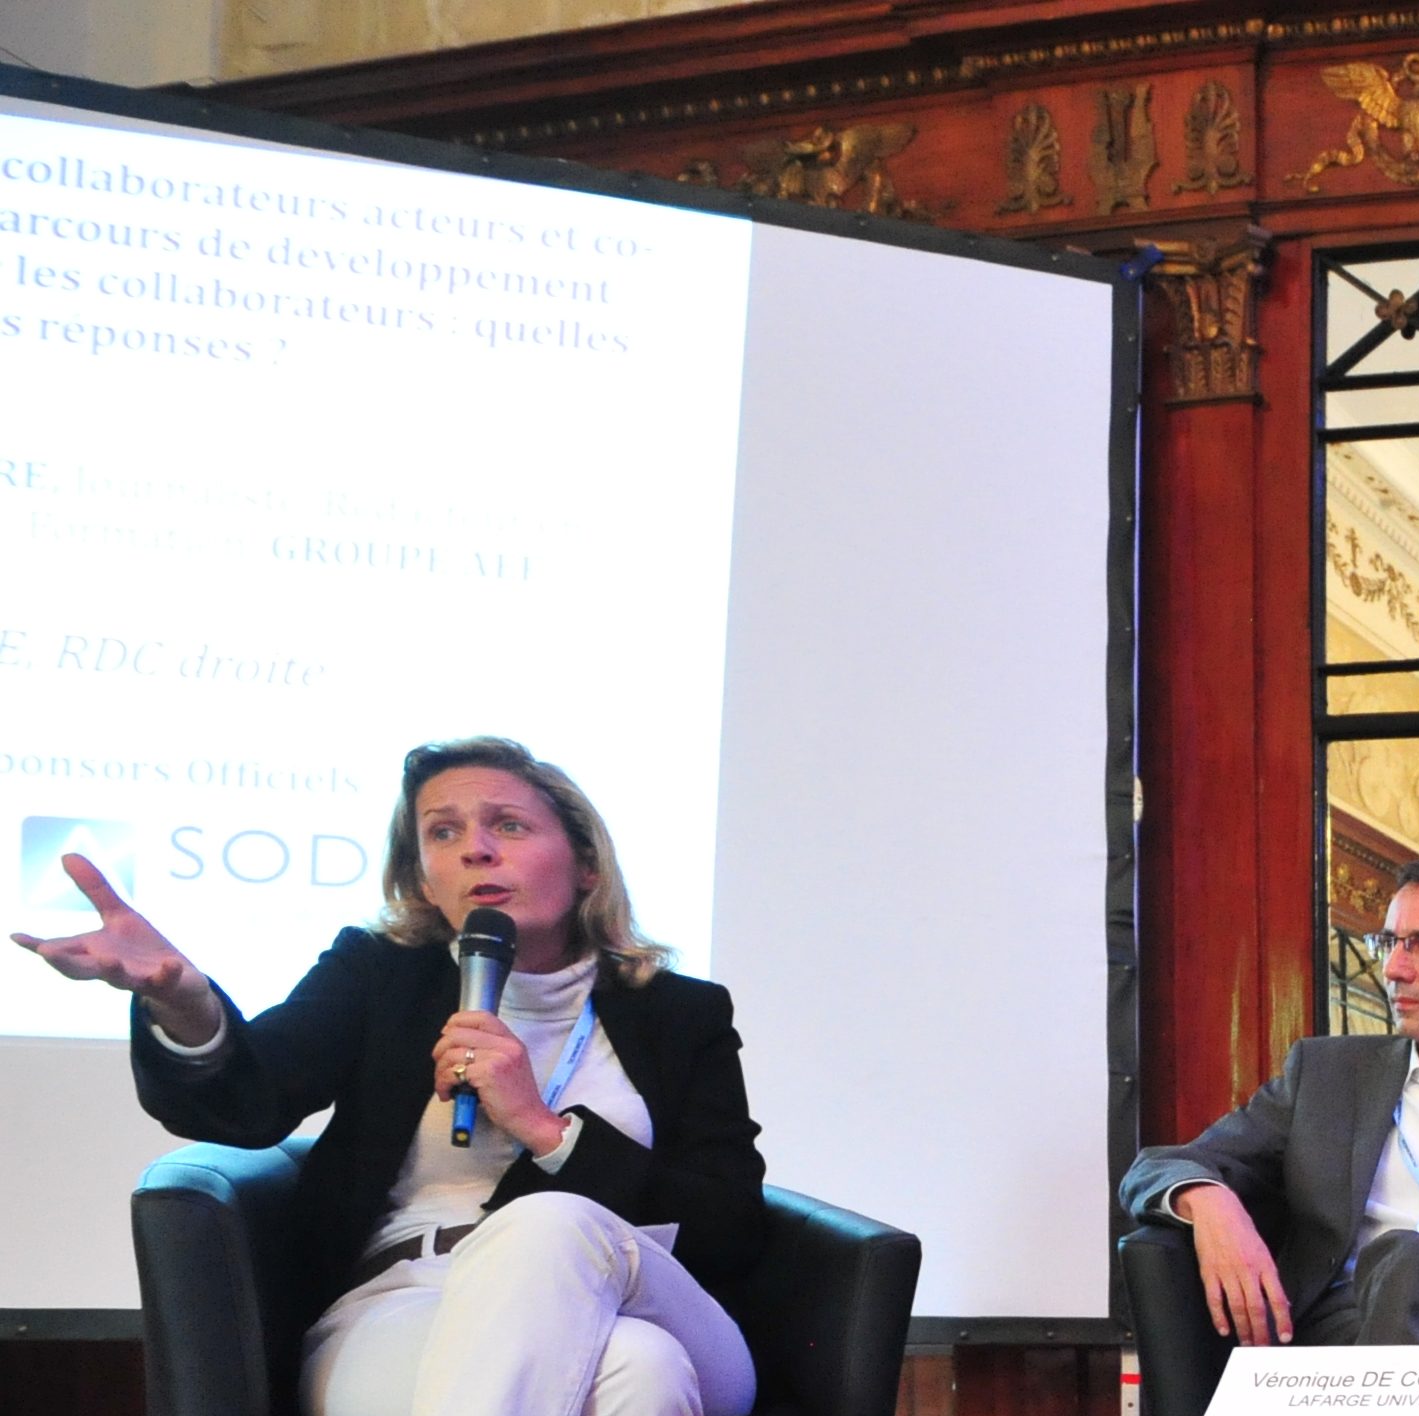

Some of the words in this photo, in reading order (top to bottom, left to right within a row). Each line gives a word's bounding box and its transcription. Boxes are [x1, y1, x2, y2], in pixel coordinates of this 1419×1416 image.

[2, 155, 349, 224] collaborateurs
[363, 205, 525, 245] acteurs
[541, 226, 578, 252] et
[594, 235, 657, 260] co-
[196, 231, 251, 262] de
[17, 255, 80, 291] les
[97, 268, 434, 331] collaborateurs
[475, 319, 630, 355] quelles
[38, 312, 255, 362] réponses
[272, 338, 288, 366] ?
[270, 535, 446, 574] GROUPE
[56, 633, 164, 676] RDC
[179, 643, 327, 686] droite
[187, 758, 359, 794] Officiels
[170, 826, 367, 886] SOD
[1253, 1370, 1354, 1392] Véronique
[1362, 1371, 1395, 1387] DE
[1288, 1394, 1372, 1407] LAFARGE
